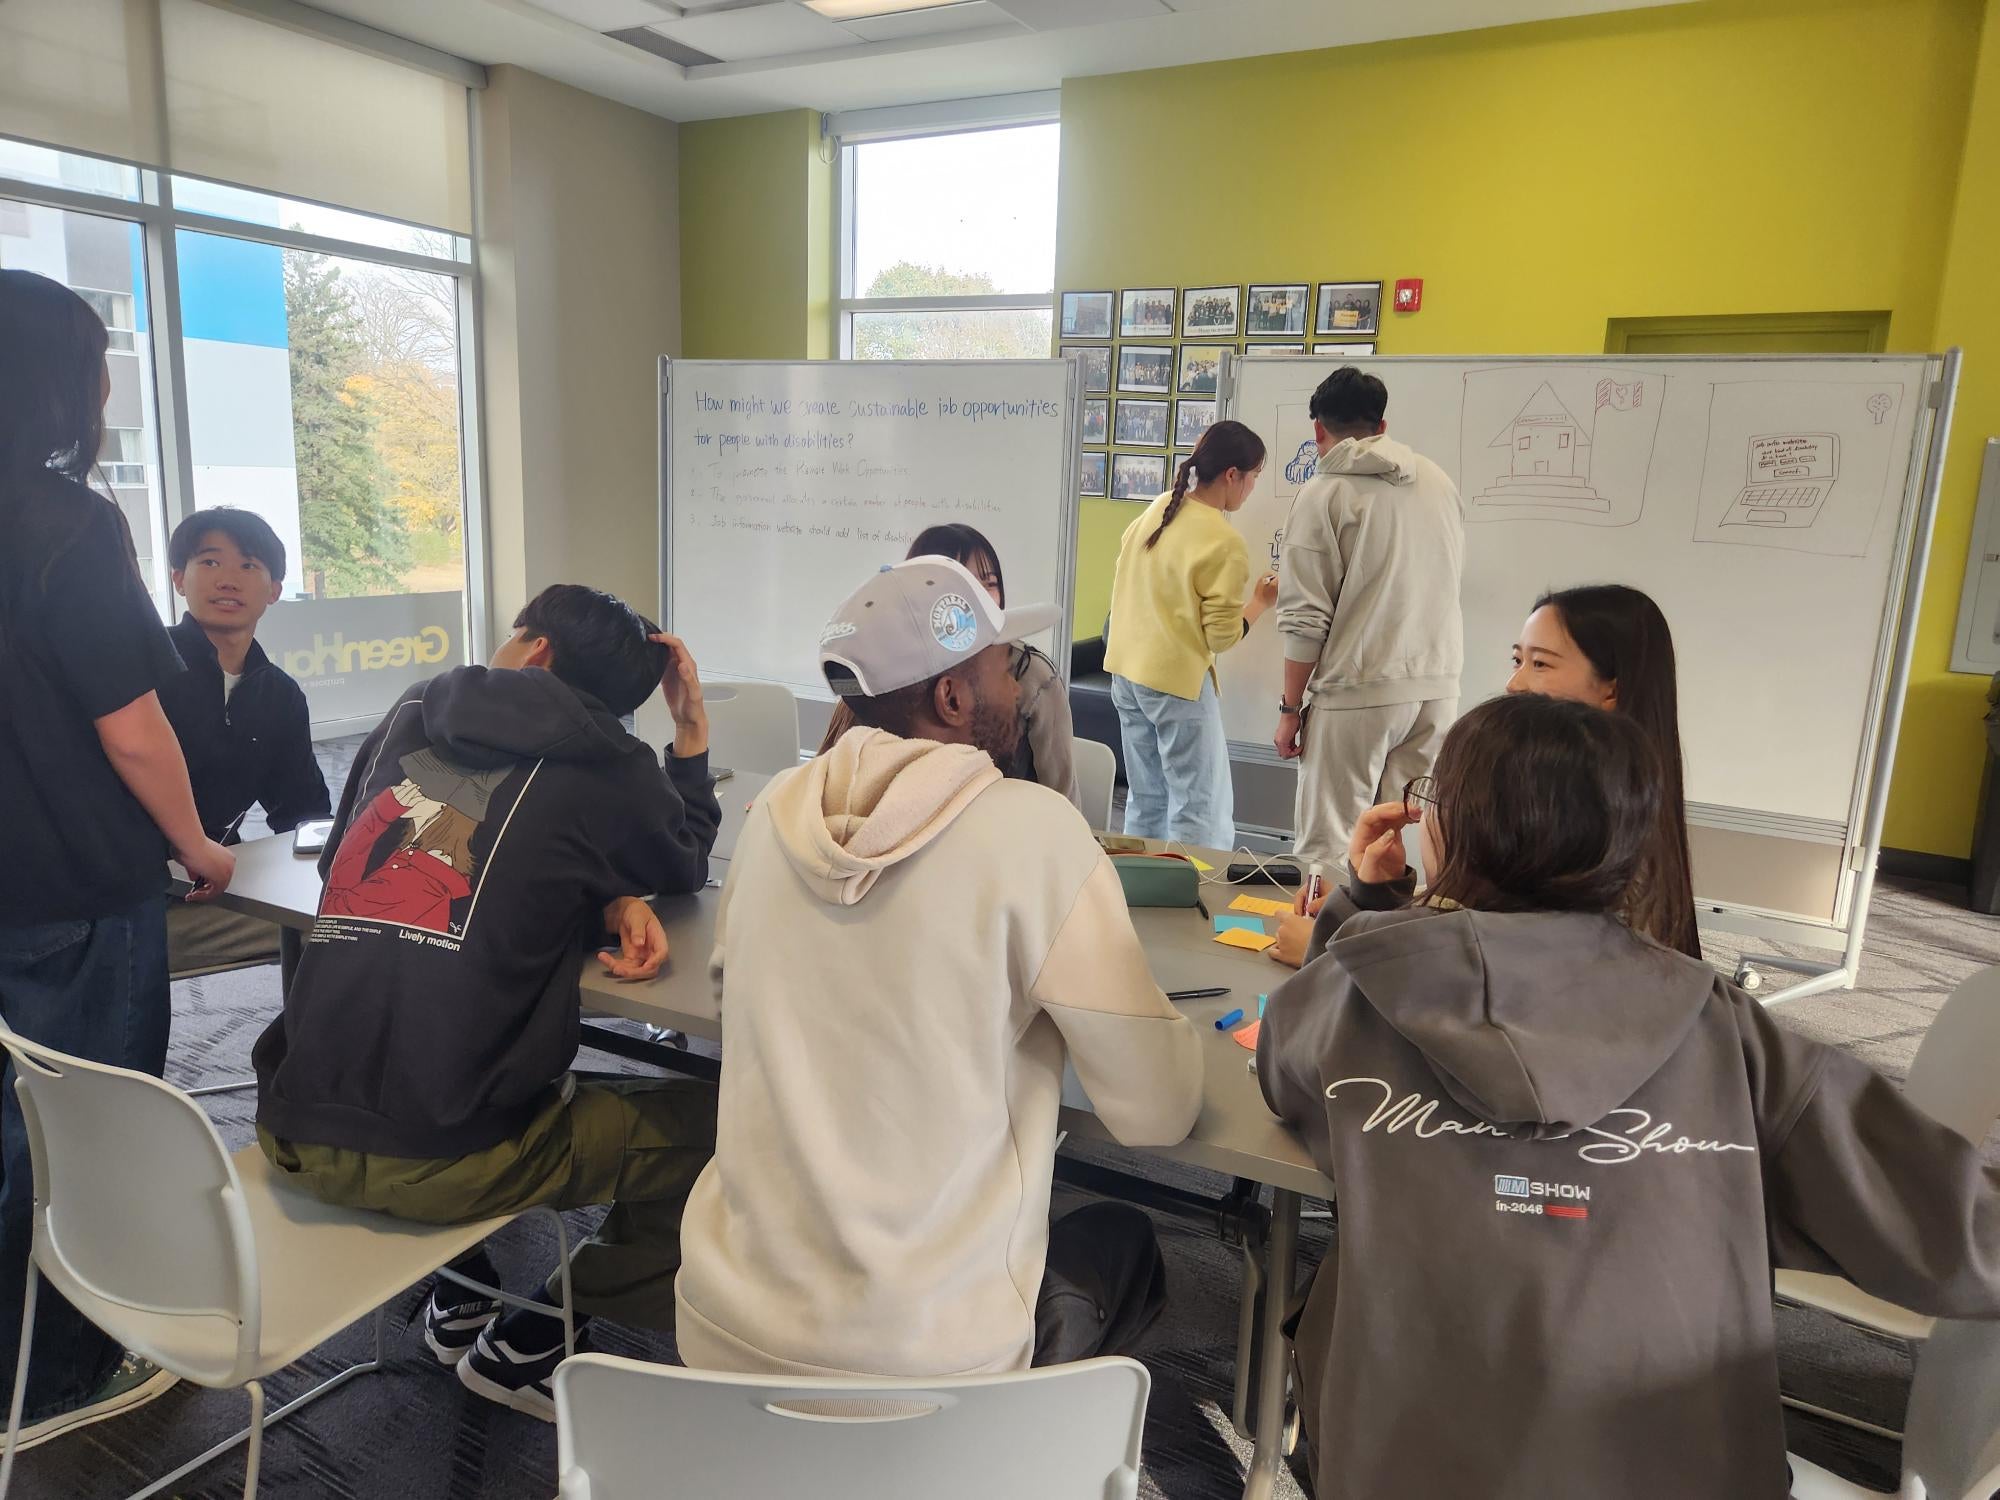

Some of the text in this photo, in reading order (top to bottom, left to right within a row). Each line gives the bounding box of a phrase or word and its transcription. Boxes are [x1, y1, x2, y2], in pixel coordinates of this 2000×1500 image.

[695, 390, 724, 412] How
[730, 395, 766, 420] might
[770, 399, 792, 415] we
[850, 398, 929, 419] sustainable
[938, 397, 958, 419] job
[962, 399, 1060, 423] opportunities
[694, 428, 854, 456] for people with disabilities?
[399, 929, 461, 952] Lively motion
[1495, 1200, 1543, 1215] in-2046
[458, 1301, 482, 1315] NIKE
